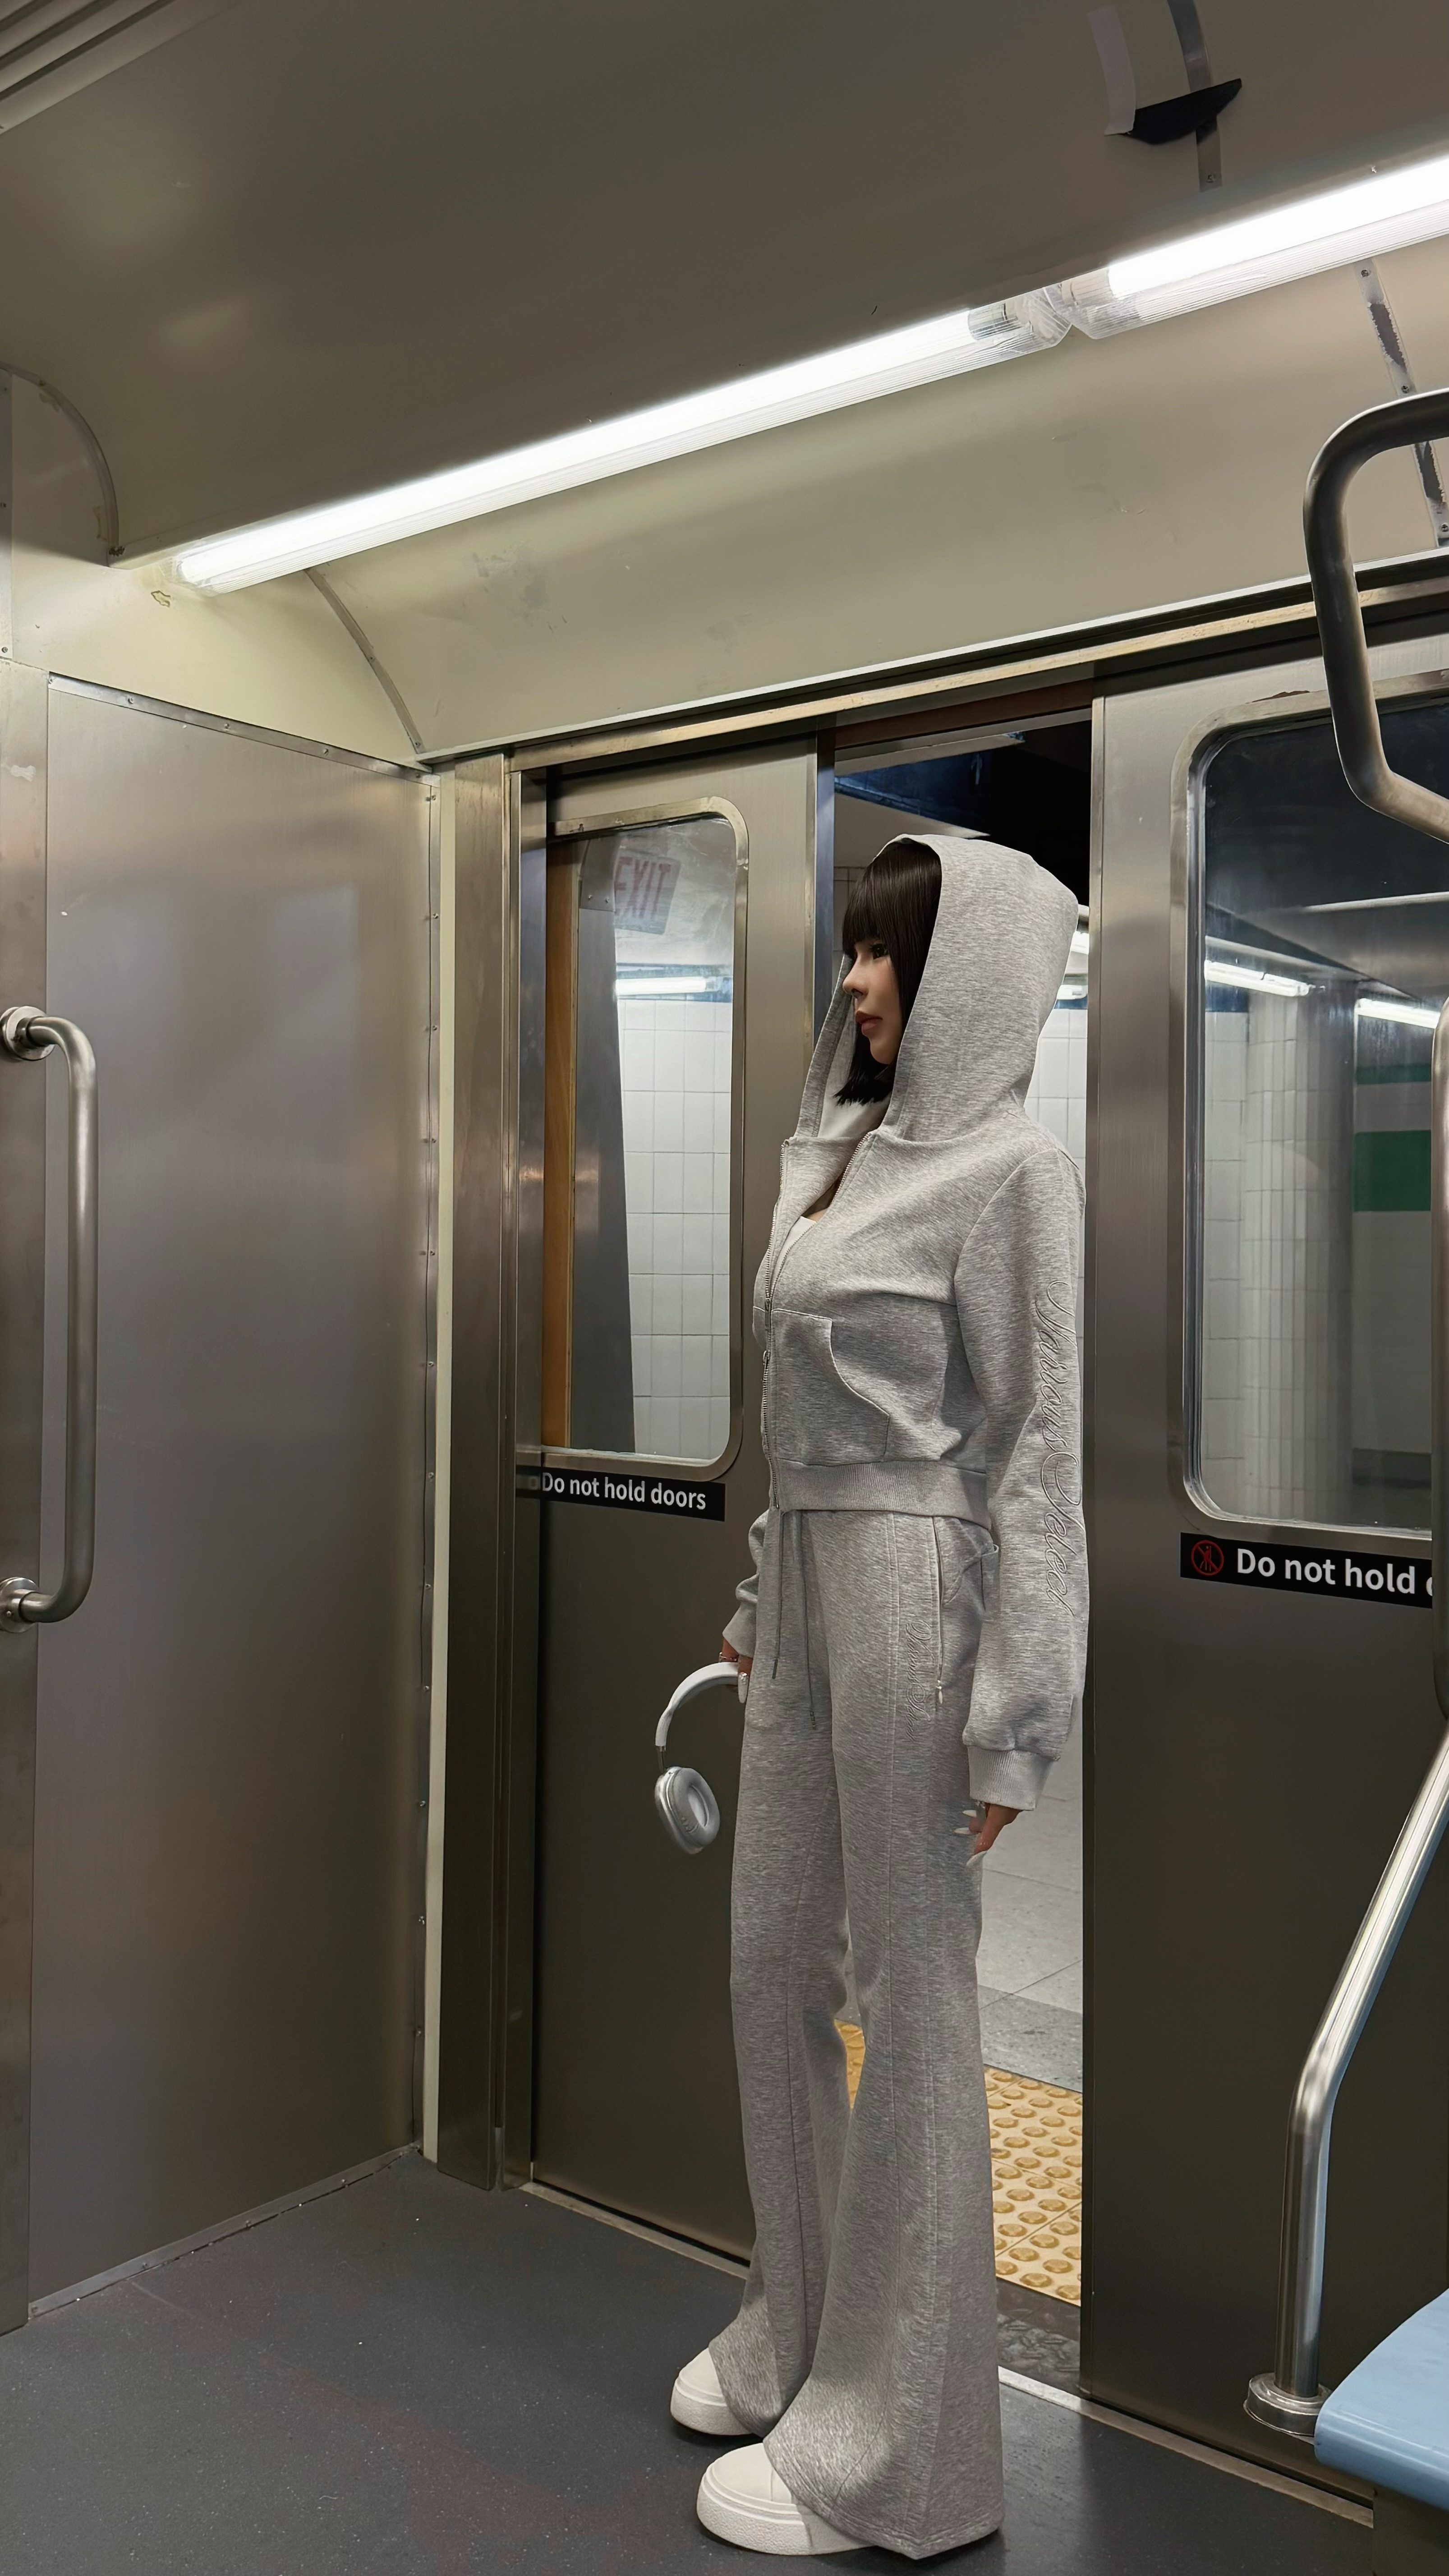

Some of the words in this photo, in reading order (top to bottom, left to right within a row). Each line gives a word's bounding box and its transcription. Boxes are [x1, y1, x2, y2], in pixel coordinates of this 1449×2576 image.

[614, 856, 672, 919] EXIT
[543, 1472, 565, 1494] Do
[570, 1478, 600, 1497] not
[604, 1477, 645, 1502] hold
[651, 1482, 706, 1510] doors
[1237, 1548, 1275, 1577] Do
[1285, 1559, 1336, 1585] not
[1345, 1559, 1415, 1594] hold
